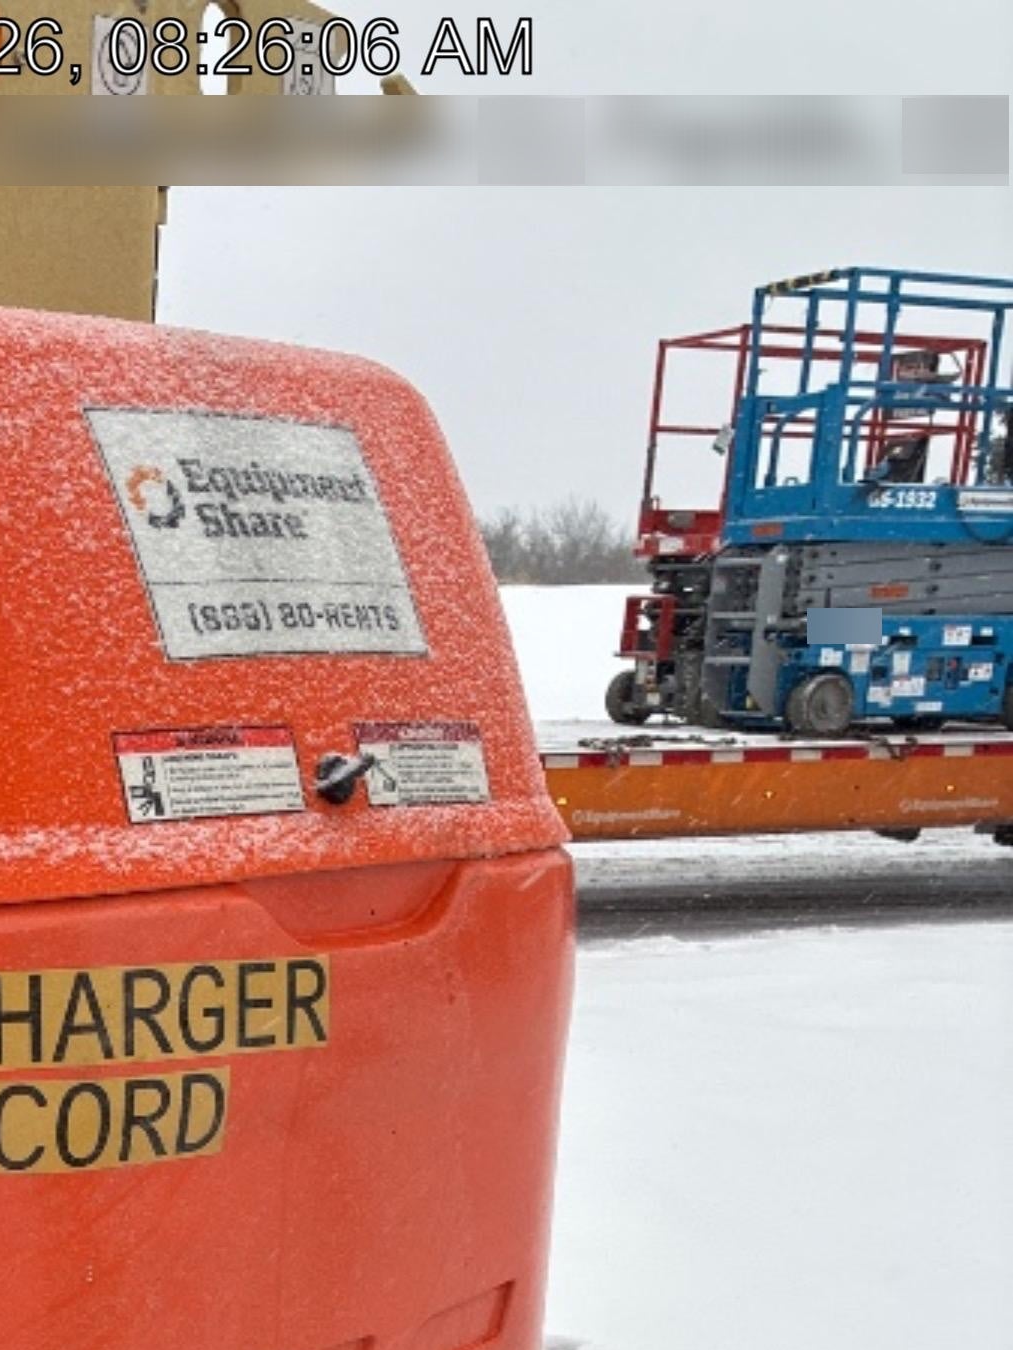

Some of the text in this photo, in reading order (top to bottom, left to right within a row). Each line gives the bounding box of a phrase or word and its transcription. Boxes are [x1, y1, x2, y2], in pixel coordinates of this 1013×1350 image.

[177, 458, 366, 504] Equipment
[194, 502, 309, 539] Share
[277, 602, 400, 632] 80-RENTS
